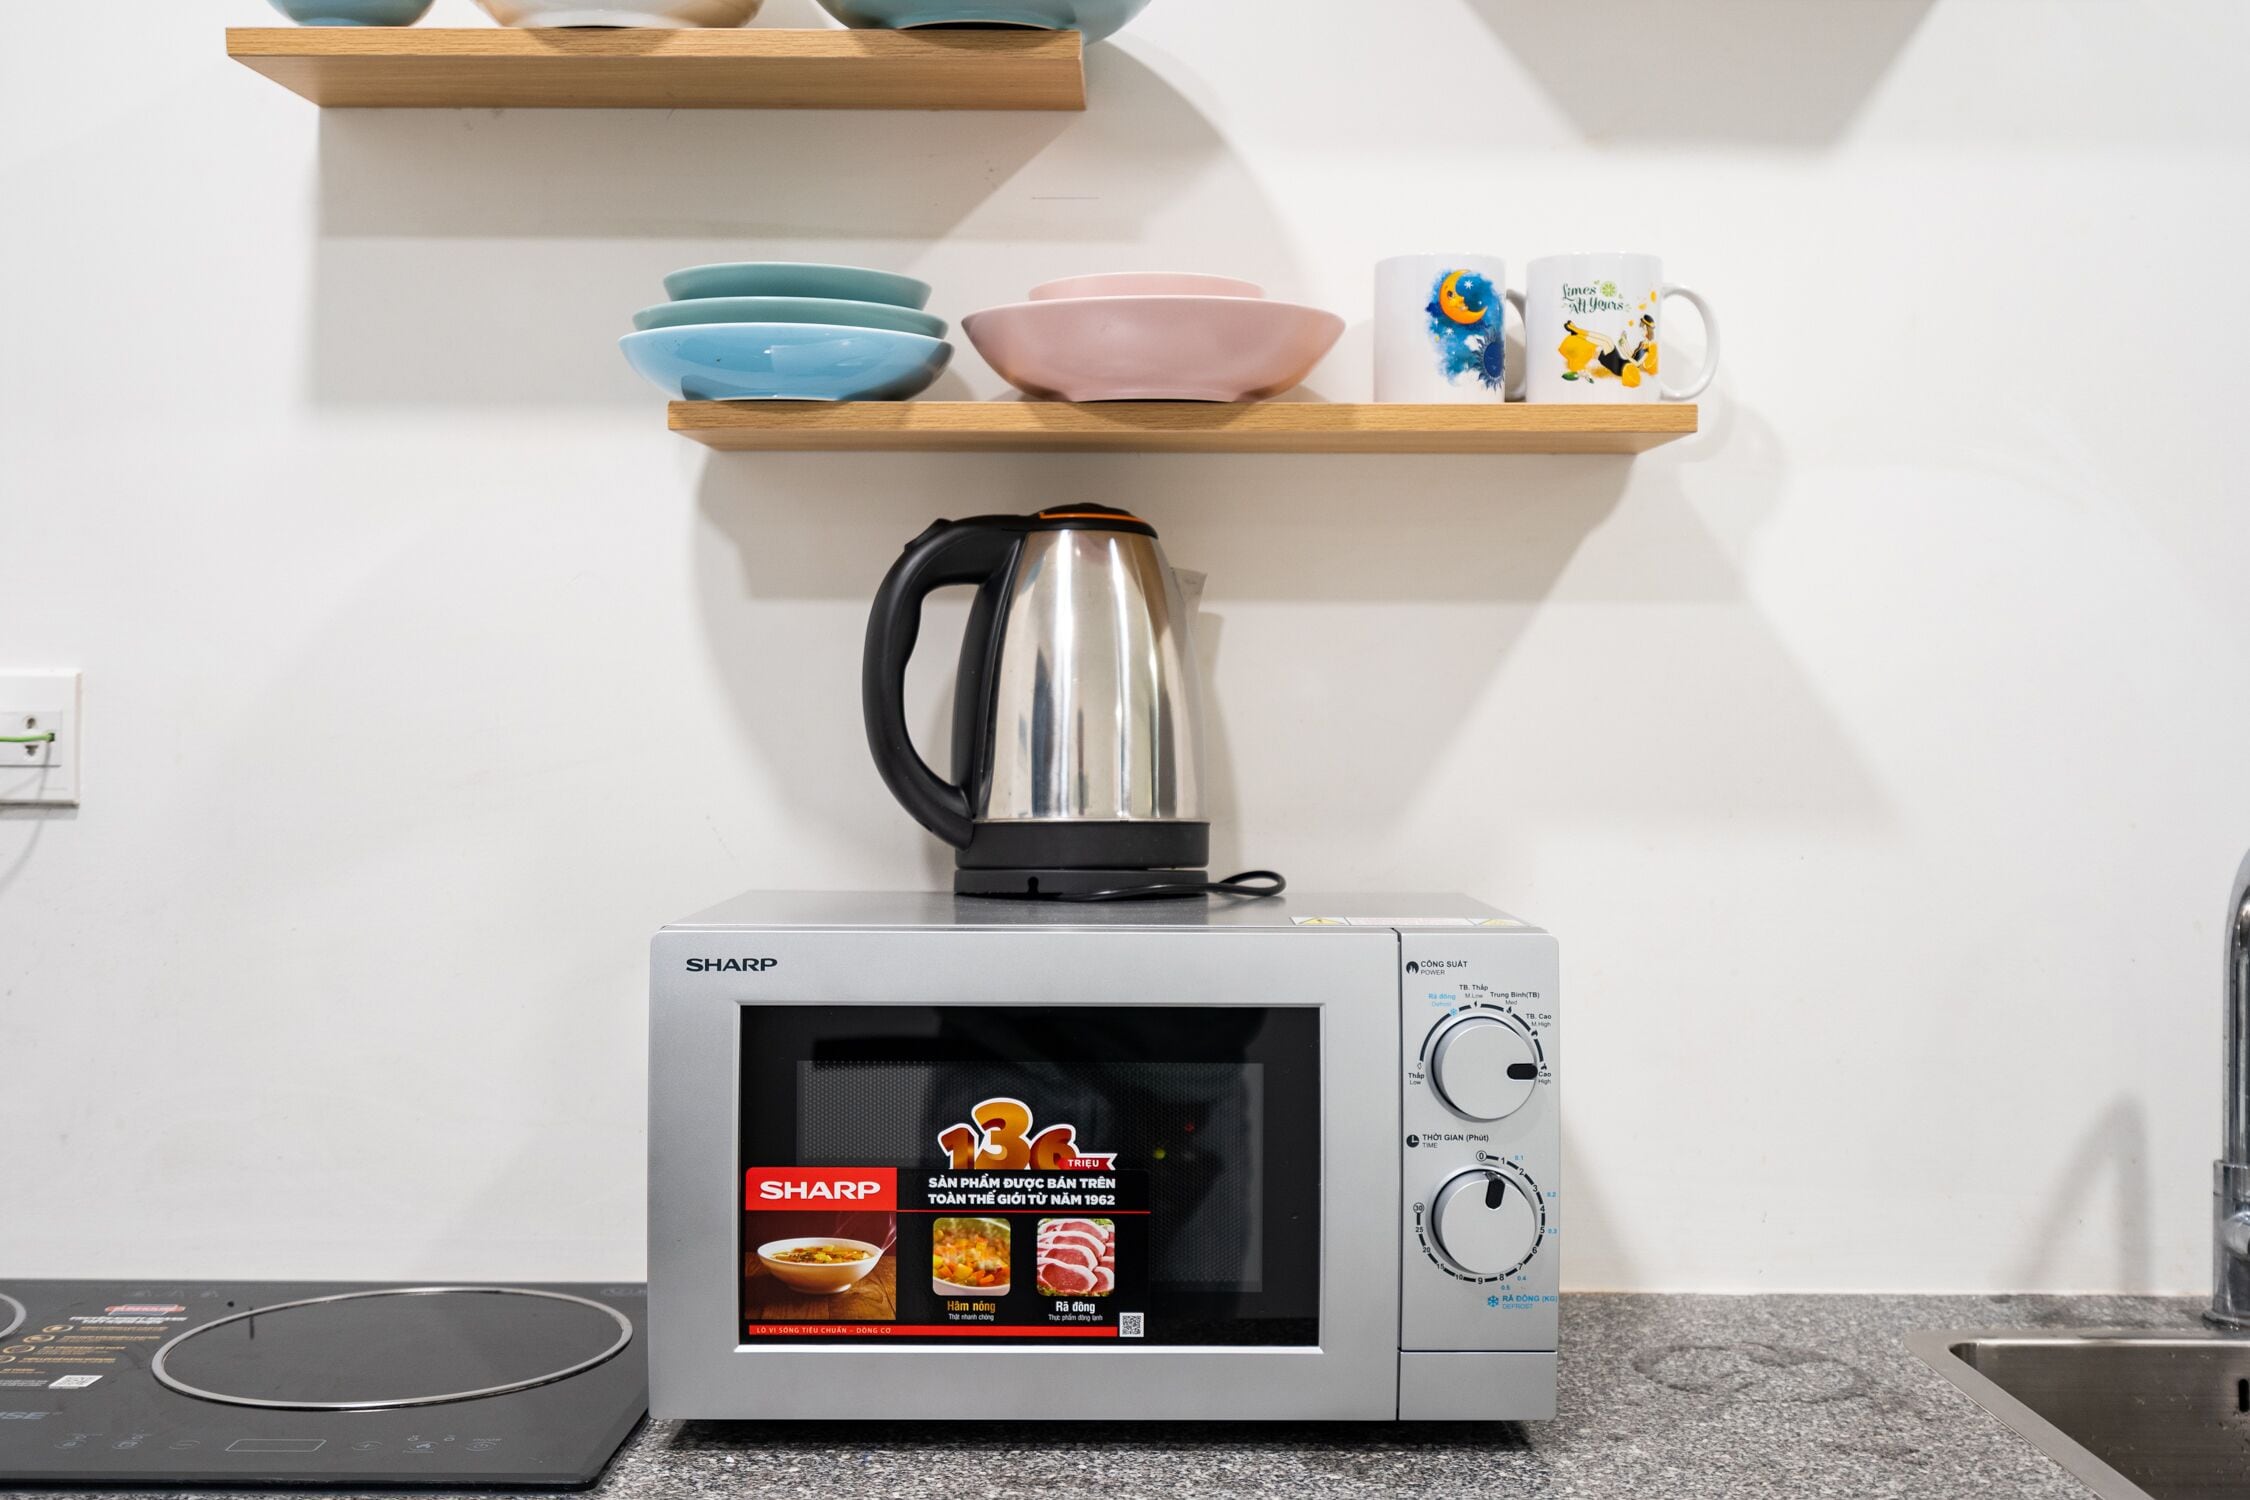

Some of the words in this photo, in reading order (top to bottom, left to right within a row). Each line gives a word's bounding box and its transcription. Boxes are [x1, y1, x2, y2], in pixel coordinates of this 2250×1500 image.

[686, 958, 778, 972] SHARP
[1420, 960, 1445, 968] CÔNG
[938, 1098, 1078, 1170] 136
[1067, 1159, 1100, 1168] TRIỆU
[1519, 1168, 1524, 1176] 2
[1002, 1178, 1044, 1192] ĐƯỢC
[1047, 1177, 1077, 1189] BÁN
[1079, 1176, 1116, 1189] TRÊN
[1532, 1184, 1538, 1192] 3
[760, 1181, 881, 1200] SHARP
[928, 1191, 967, 1205] TOÀN
[968, 1190, 995, 1205] THẾ
[997, 1193, 1026, 1205] GIỚI
[1028, 1192, 1048, 1206] TỪ
[1051, 1193, 1082, 1206] NĂM
[1084, 1195, 1116, 1206] 1962
[1539, 1204, 1545, 1212] 4
[1540, 1226, 1545, 1234] 5
[1532, 1246, 1538, 1254] 6
[1477, 1277, 1483, 1285] 9
[1499, 1273, 1505, 1281] 8
[947, 1300, 969, 1312] Hâm
[1072, 1300, 1096, 1313] đông
[961, 1313, 978, 1321] nhanh
